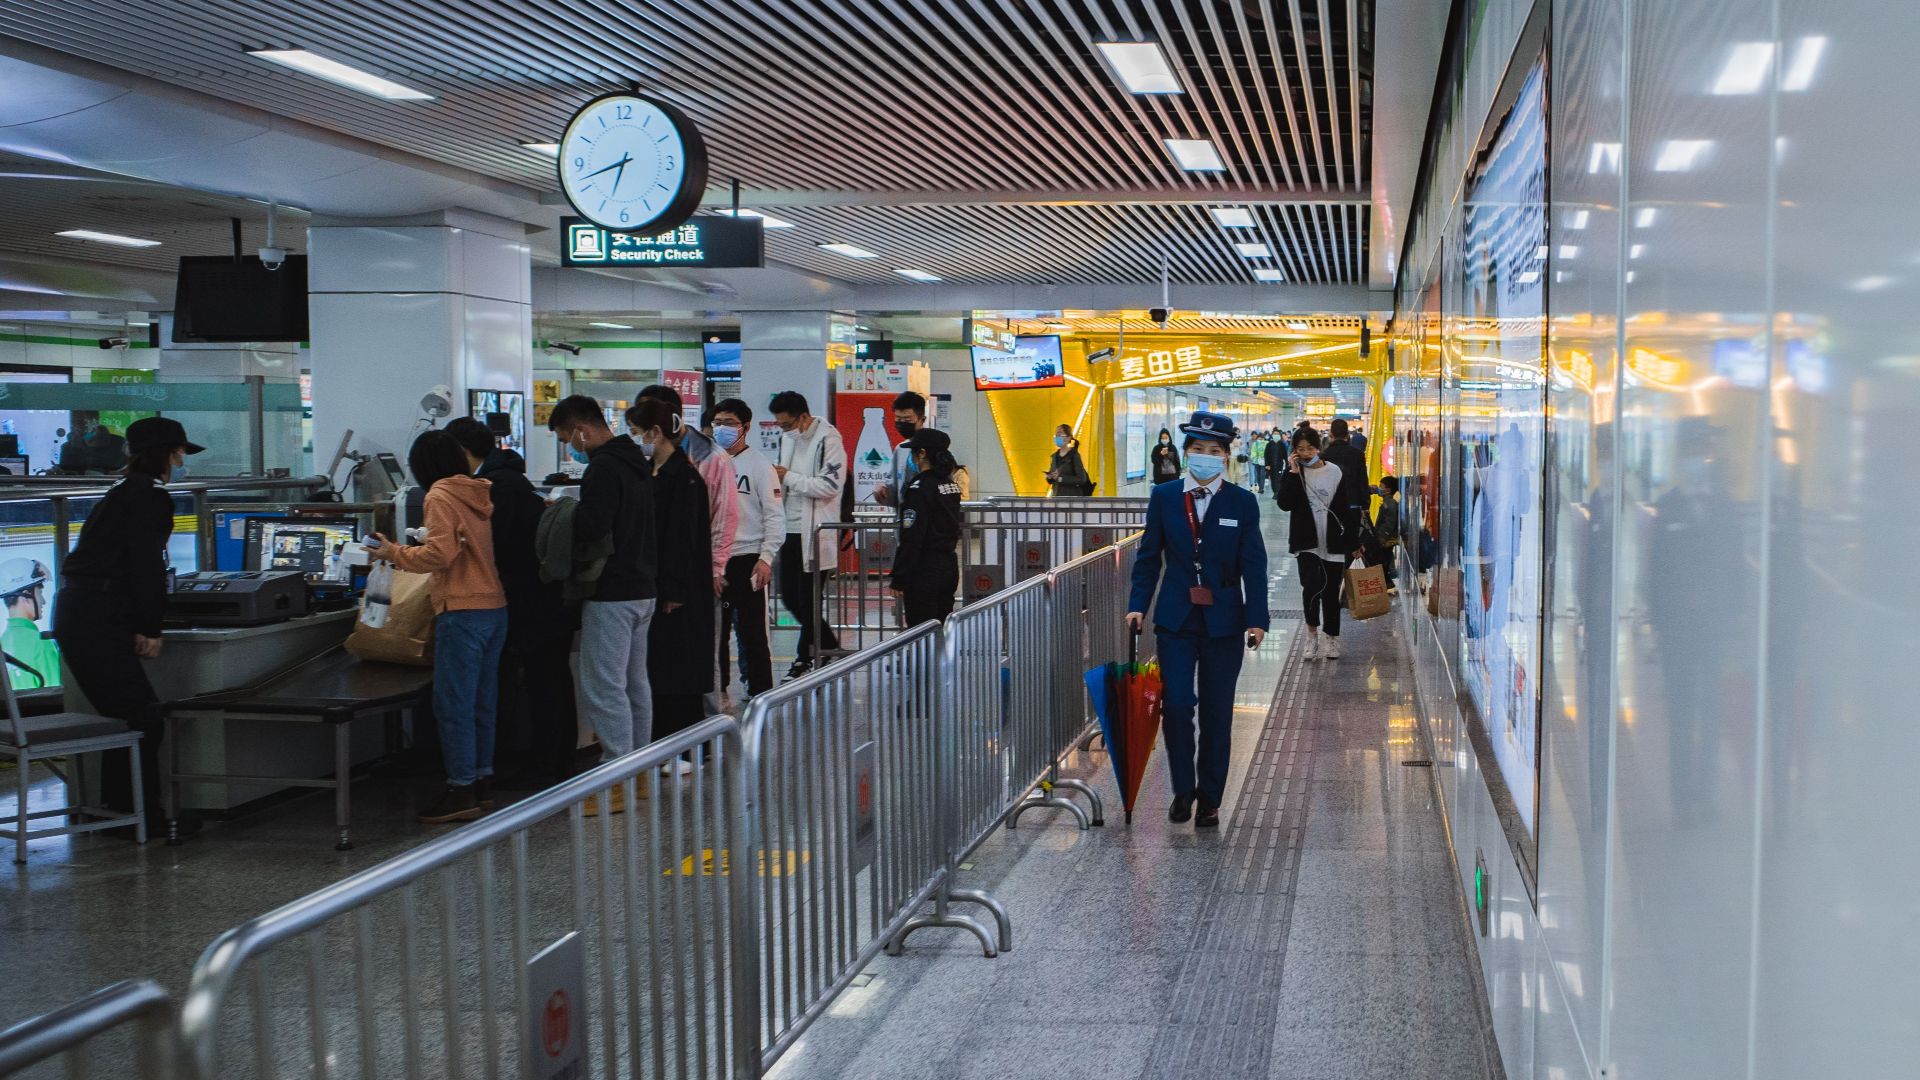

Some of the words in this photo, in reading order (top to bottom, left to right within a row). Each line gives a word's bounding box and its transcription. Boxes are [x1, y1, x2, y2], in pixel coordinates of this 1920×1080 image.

[616, 104, 632, 120] 12
[574, 157, 585, 172] 9
[666, 155, 675, 171] 3
[620, 207, 630, 223] 6
[611, 249, 663, 262] Security
[664, 249, 705, 260] Check
[1119, 345, 1204, 381] 麦田里
[1199, 362, 1281, 385] 地铁商业街
